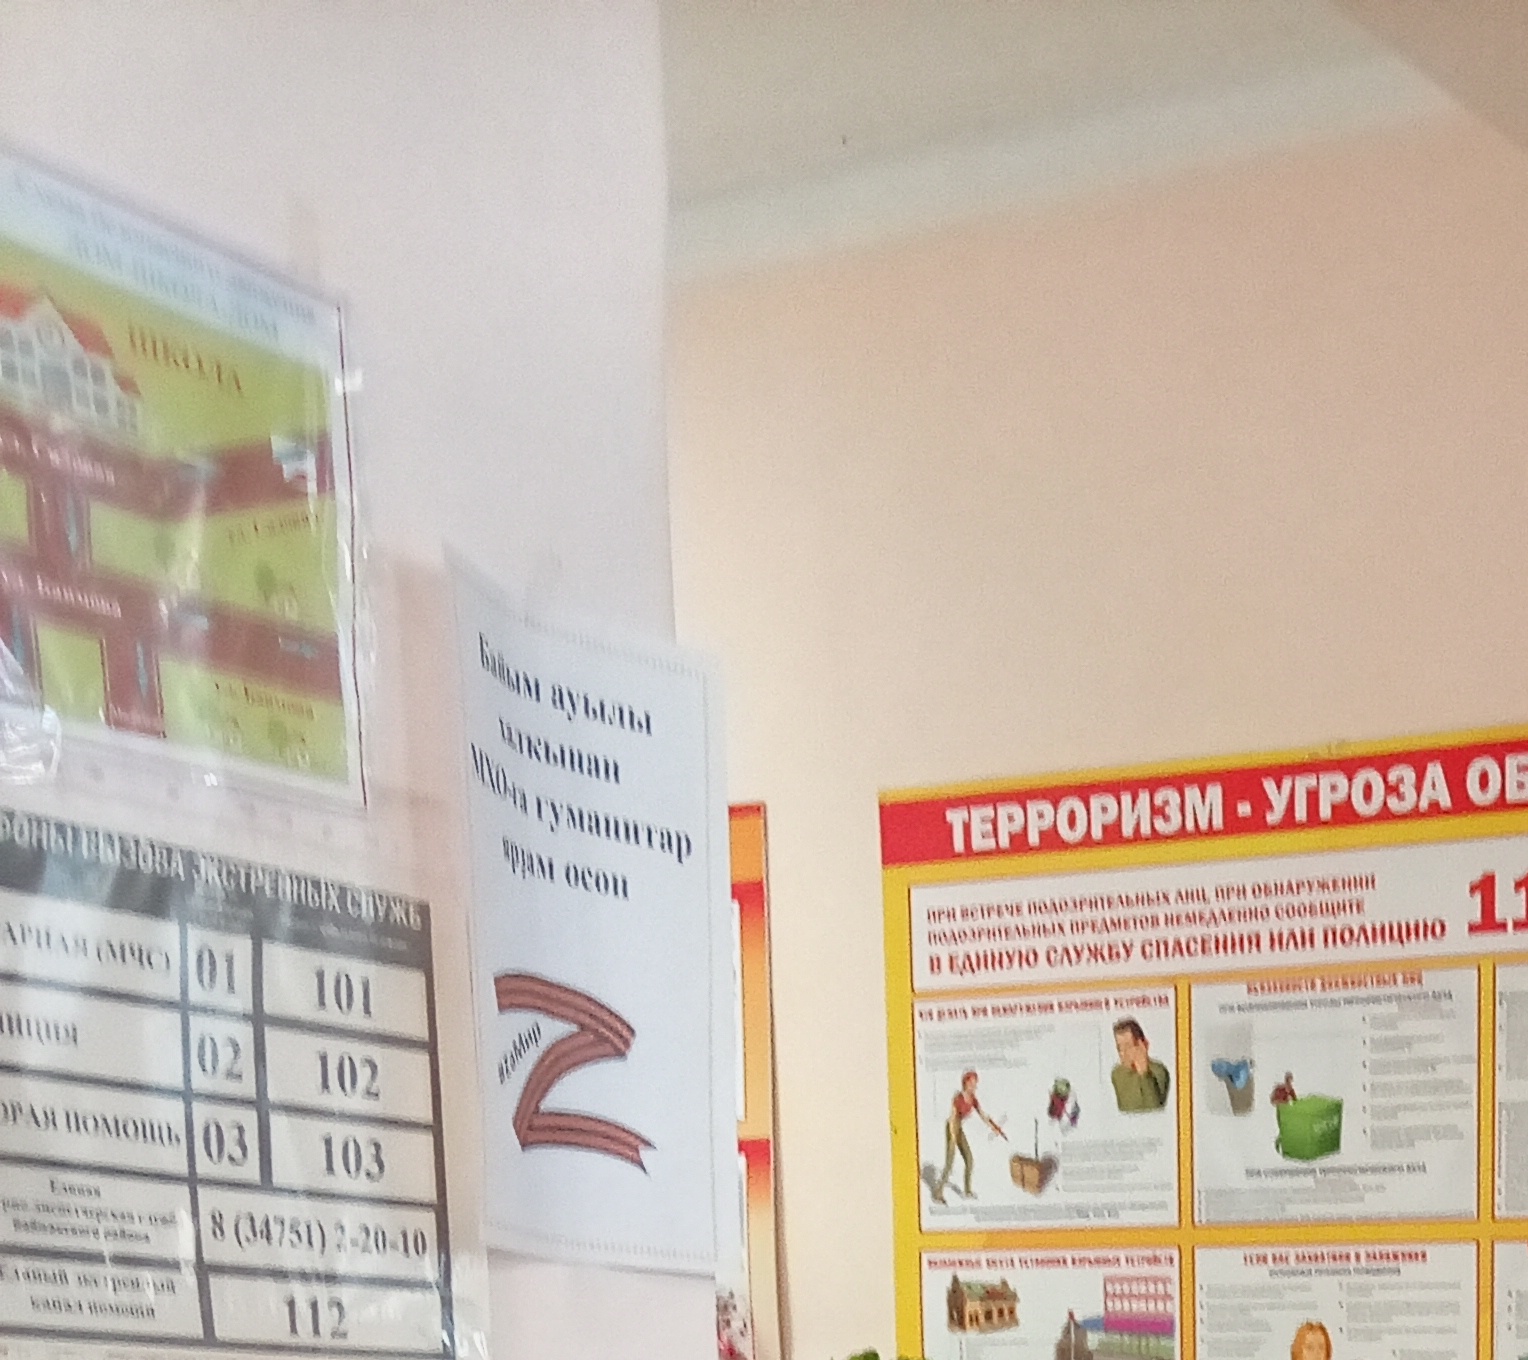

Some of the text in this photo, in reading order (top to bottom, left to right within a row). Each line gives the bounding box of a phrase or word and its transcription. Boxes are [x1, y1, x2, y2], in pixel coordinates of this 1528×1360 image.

[551, 682, 652, 737] ауылы
[536, 794, 692, 866] гуманитар
[945, 781, 1224, 854] ТЕРРОРИЗМ
[1237, 799, 1252, 818] -
[1260, 759, 1453, 826] УГРОЗА
[1251, 872, 1376, 898] ОБНАРУЖЕНИИ
[1274, 898, 1366, 921] СООБЩИТЕ
[195, 943, 236, 994] 01
[948, 947, 1040, 977] ЕДИНУЮ
[1045, 938, 1135, 968] СЛУЖБУ
[1141, 931, 1262, 962] СПАСЕНИЯ
[1268, 928, 1316, 951] ИЛИ
[1322, 916, 1447, 948] ПОЛИЦИЮ
[316, 967, 372, 1018] 101
[196, 1032, 244, 1083] 02
[316, 1047, 381, 1101] 102
[64, 1108, 182, 1148] ПОМОЩЬ
[202, 1118, 249, 1168] 03
[322, 1130, 386, 1183] 103
[210, 1207, 226, 1243] 8
[283, 1292, 349, 1340] 112
